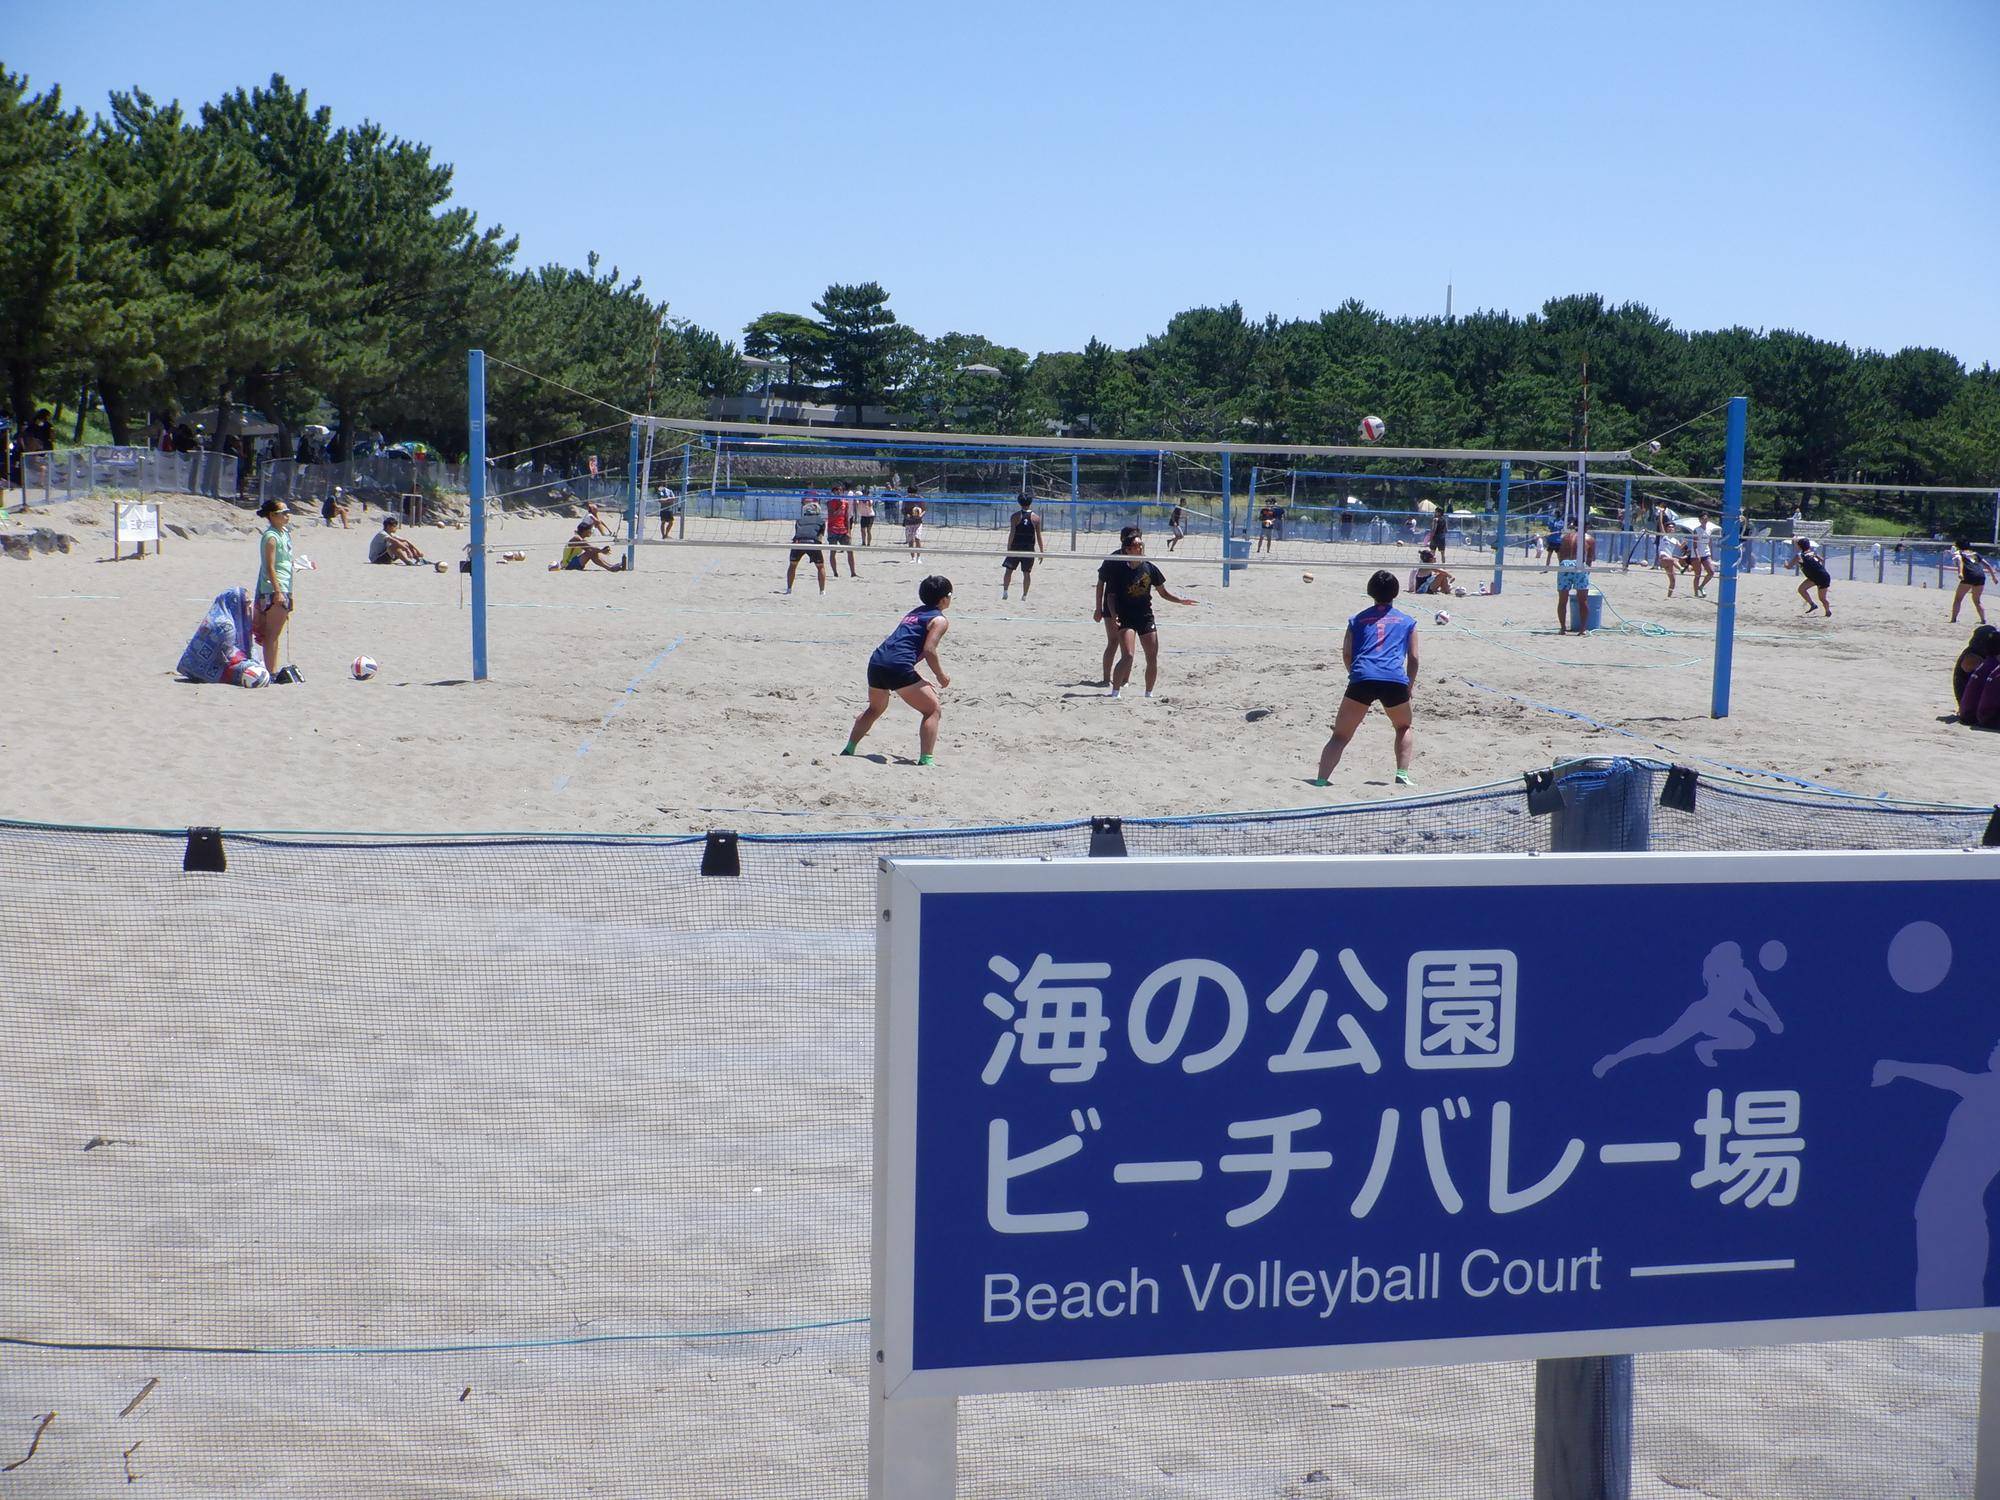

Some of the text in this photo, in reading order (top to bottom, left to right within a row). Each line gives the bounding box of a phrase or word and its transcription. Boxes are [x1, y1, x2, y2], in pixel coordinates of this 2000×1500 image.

[981, 948, 1519, 1085] 海の公園
[986, 1088, 1805, 1234] ビーチバレー場
[983, 1247, 1603, 1323] Beach Volleyball Court
